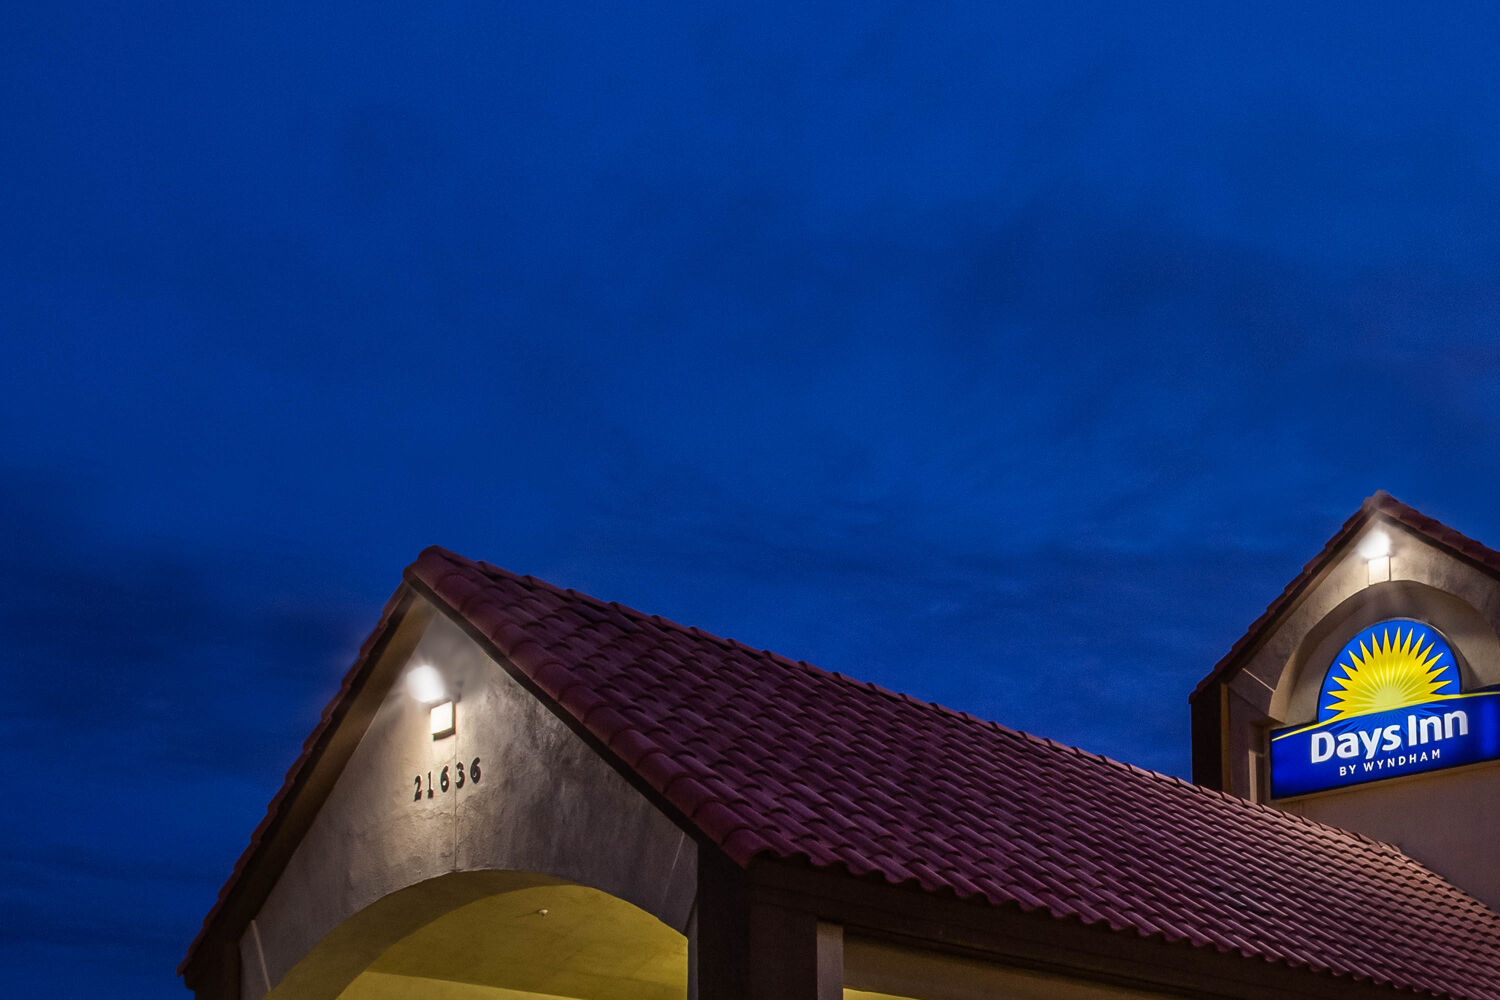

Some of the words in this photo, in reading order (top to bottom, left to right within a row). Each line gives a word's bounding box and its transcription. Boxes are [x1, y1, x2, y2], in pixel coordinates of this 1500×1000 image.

[1311, 725, 1401, 764] Days
[1408, 710, 1468, 747] Inn
[414, 757, 481, 802] 21636
[1339, 764, 1356, 776] BY
[1364, 749, 1441, 772] WYNDHAM
